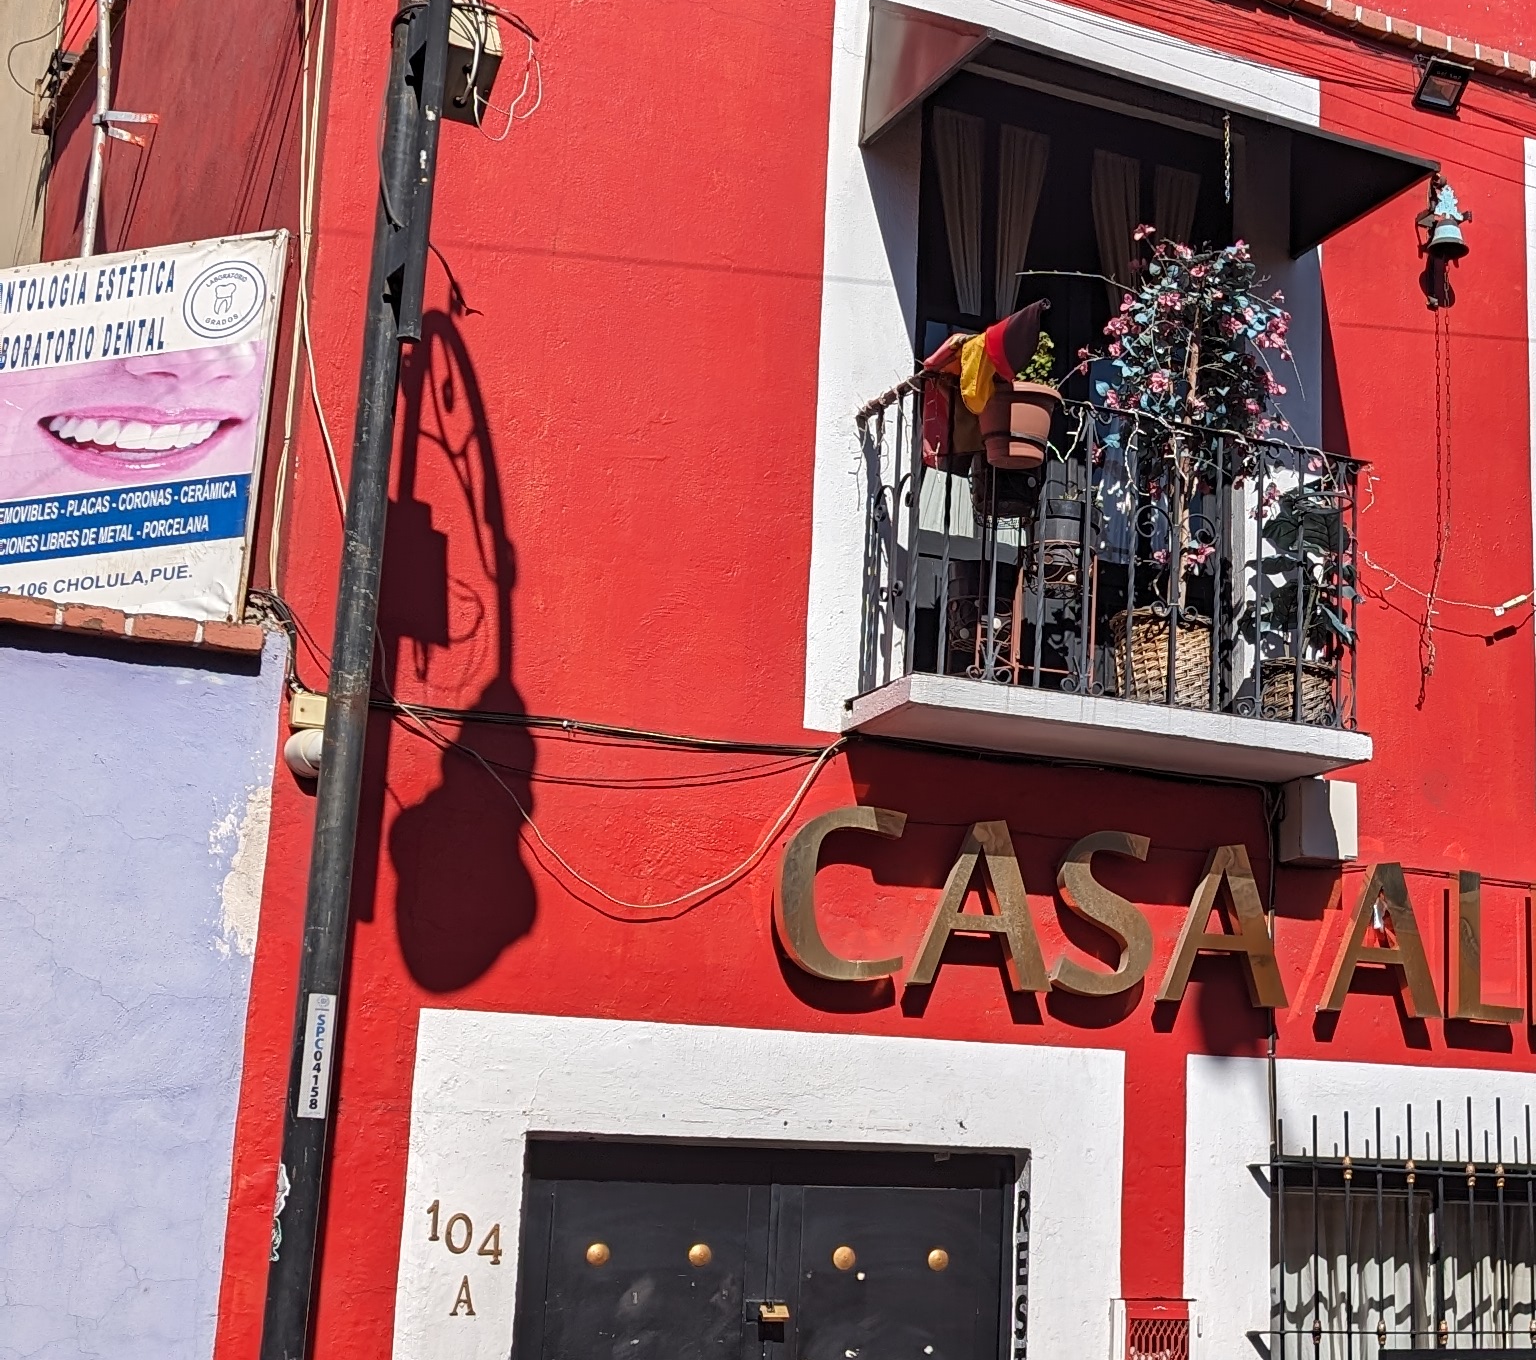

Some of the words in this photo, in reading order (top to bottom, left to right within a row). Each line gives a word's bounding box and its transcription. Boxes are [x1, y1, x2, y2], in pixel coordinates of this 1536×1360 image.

[0, 265, 87, 314] NTOLOGÍA
[206, 273, 247, 287] LABORATORIO
[101, 317, 165, 357] DENTAL
[205, 314, 238, 325] GRADOS
[66, 495, 110, 517] PLACAS
[118, 488, 172, 511] CORONAS
[180, 479, 237, 504] CERÁMICA
[40, 530, 79, 551] LIBRES
[81, 527, 97, 546] DE
[98, 524, 134, 544] METAL
[142, 515, 209, 539] PORCELANA
[18, 582, 47, 597] 106
[774, 805, 1289, 1010] CASA
[308, 1014, 326, 1110] SPC04158
[426, 1199, 503, 1266] 104
[449, 1275, 476, 1316] A
